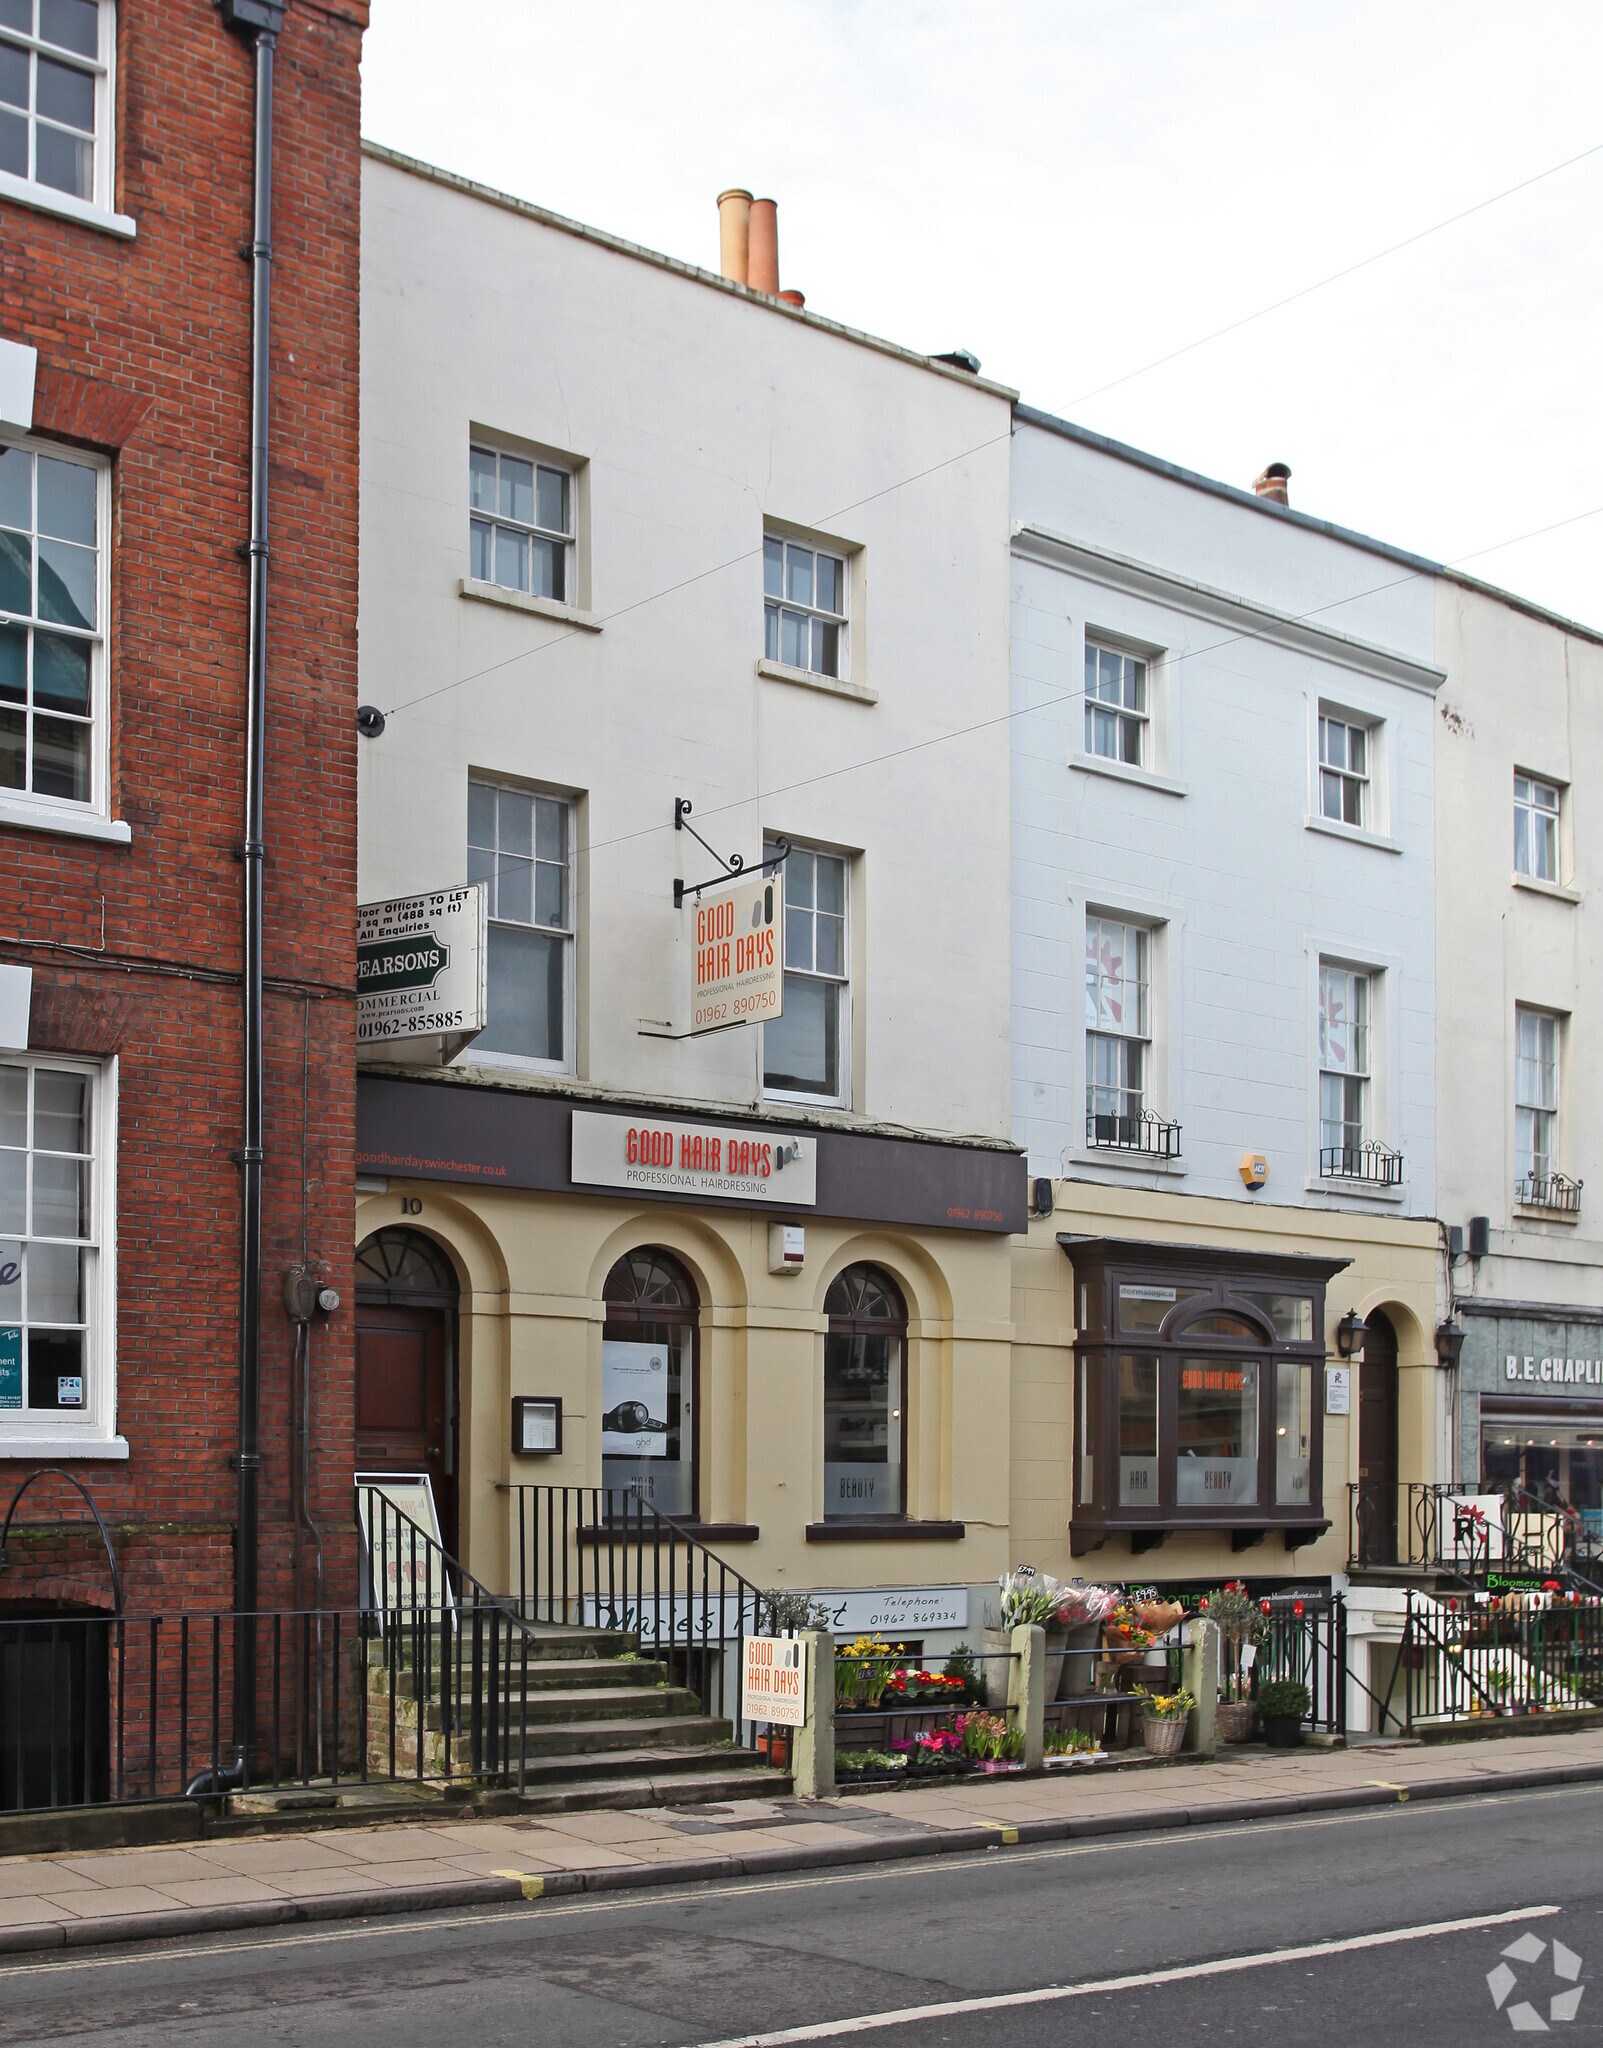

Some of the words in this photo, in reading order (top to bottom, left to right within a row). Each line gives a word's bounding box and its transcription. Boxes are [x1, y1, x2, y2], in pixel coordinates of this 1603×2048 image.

[385, 901, 425, 913] Offices
[430, 895, 444, 905] TO
[449, 891, 469, 901] LET
[366, 920, 379, 929] sq
[383, 917, 393, 925] m
[398, 909, 424, 922] (488
[429, 908, 442, 917] sq
[447, 902, 461, 913] ft)
[697, 901, 734, 945] GOOD
[360, 929, 373, 940] All
[379, 922, 430, 936] Enquiries
[697, 942, 730, 985] HAIR
[736, 929, 774, 974] DAYS
[697, 983, 734, 998] PROFESSIONAL
[736, 971, 775, 988] HAIRDRESSING
[357, 990, 441, 1011] OMMERCIAL
[696, 1003, 727, 1024] 01962
[733, 990, 776, 1015] 890750
[361, 1005, 424, 1019] www.pearsons.com
[358, 1010, 463, 1039] 01962-855885
[627, 1128, 673, 1168] GOOD
[681, 1134, 721, 1172] HAIR
[728, 1139, 771, 1177] DAYS
[627, 1170, 697, 1187] PROFESSIONAL
[701, 1177, 767, 1194] HAIRDRESSING
[402, 1197, 423, 1215] 10
[947, 1207, 970, 1219] 01962
[973, 1209, 1004, 1222] 890750
[1120, 1287, 1174, 1298] dermalogica
[1506, 1355, 1603, 1384] B.E.CHAPLI
[1183, 1370, 1203, 1389] GOOD
[1204, 1371, 1222, 1390] HAIR
[1224, 1371, 1244, 1391] DAYS
[636, 1437, 651, 1448] ghd
[631, 1476, 654, 1498] HAIR
[840, 1477, 875, 1498] BEAUTY
[1130, 1470, 1148, 1490] HAIR
[1204, 1471, 1232, 1490] BEAUTY
[1486, 1574, 1541, 1588] Bloomers
[870, 1613, 906, 1625] 01962
[913, 1612, 957, 1622] 869334
[749, 1641, 773, 1666] GOOD
[748, 1667, 771, 1692] HAIR
[774, 1669, 799, 1695] DAYS
[746, 1703, 768, 1715] 01962
[771, 1706, 800, 1719] 890750
